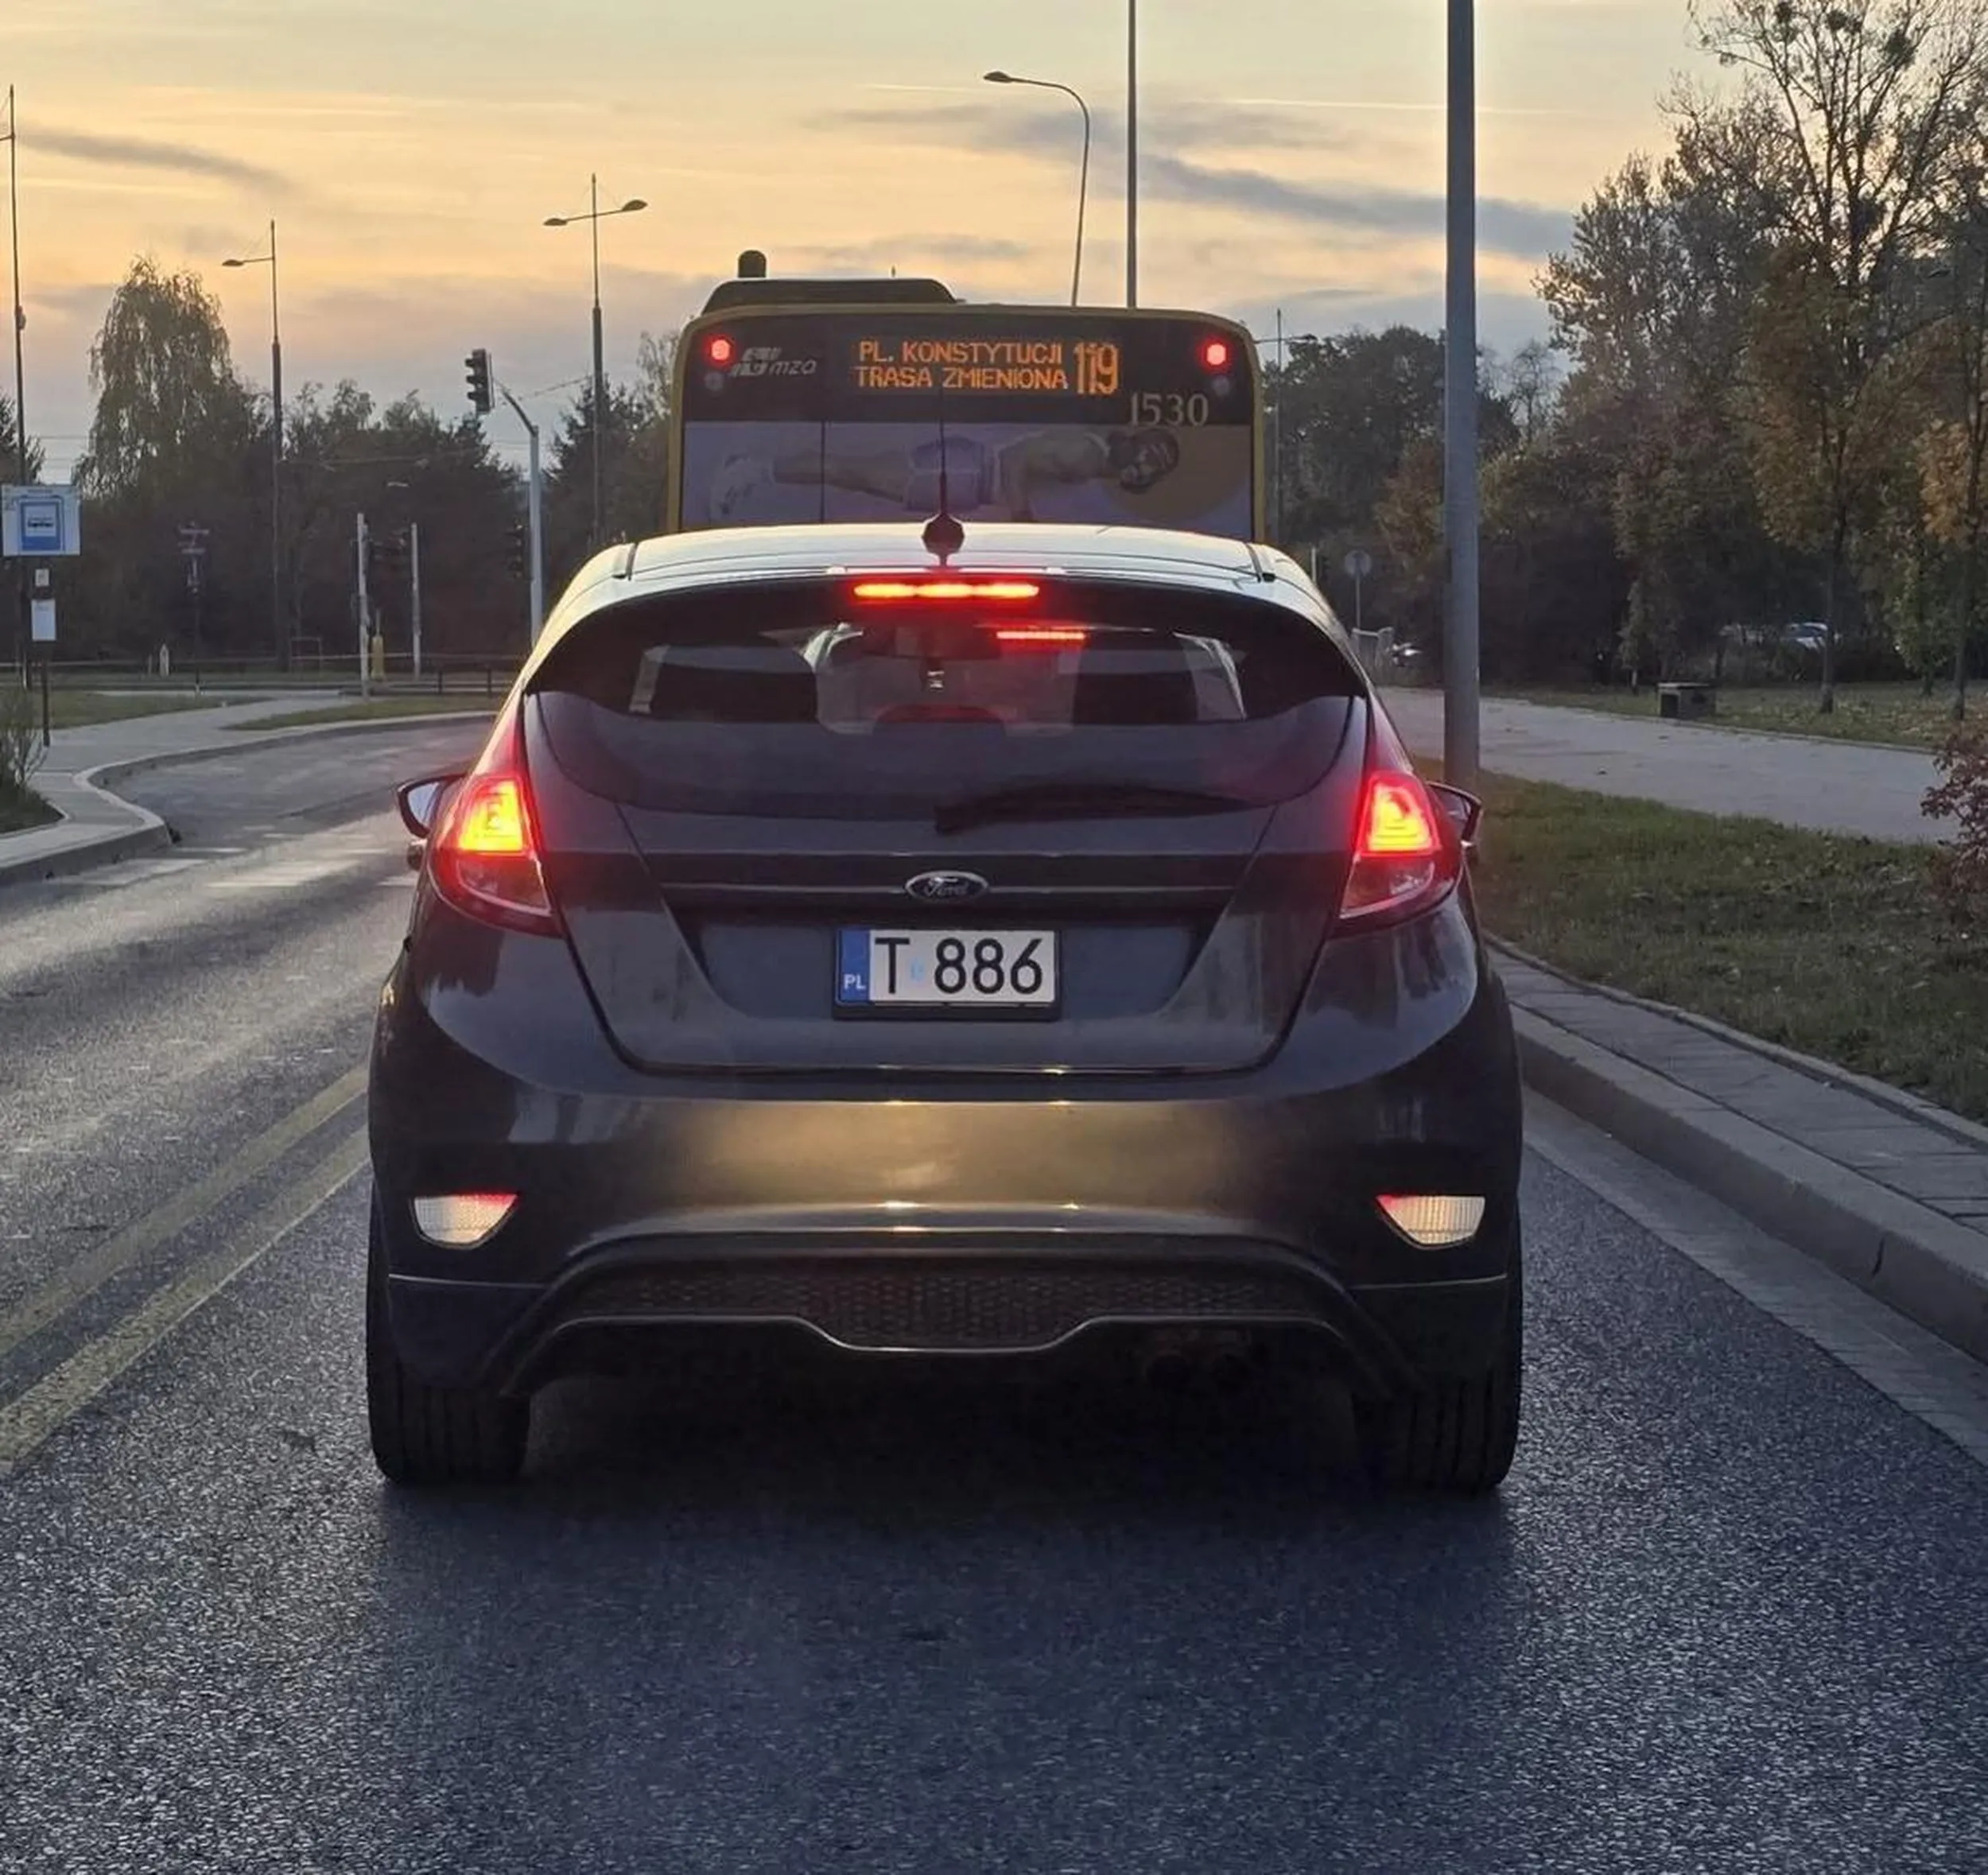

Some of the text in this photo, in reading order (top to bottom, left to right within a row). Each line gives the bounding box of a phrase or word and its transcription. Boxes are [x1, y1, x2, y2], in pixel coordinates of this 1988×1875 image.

[859, 340, 1062, 364] PL. KONSTYTUCJI
[855, 365, 1069, 390] TRASA ZMIENIONA
[1074, 342, 1119, 394] 119
[1128, 393, 1209, 427] 1530
[875, 937, 1043, 995] T 886
[844, 975, 866, 990] PL
